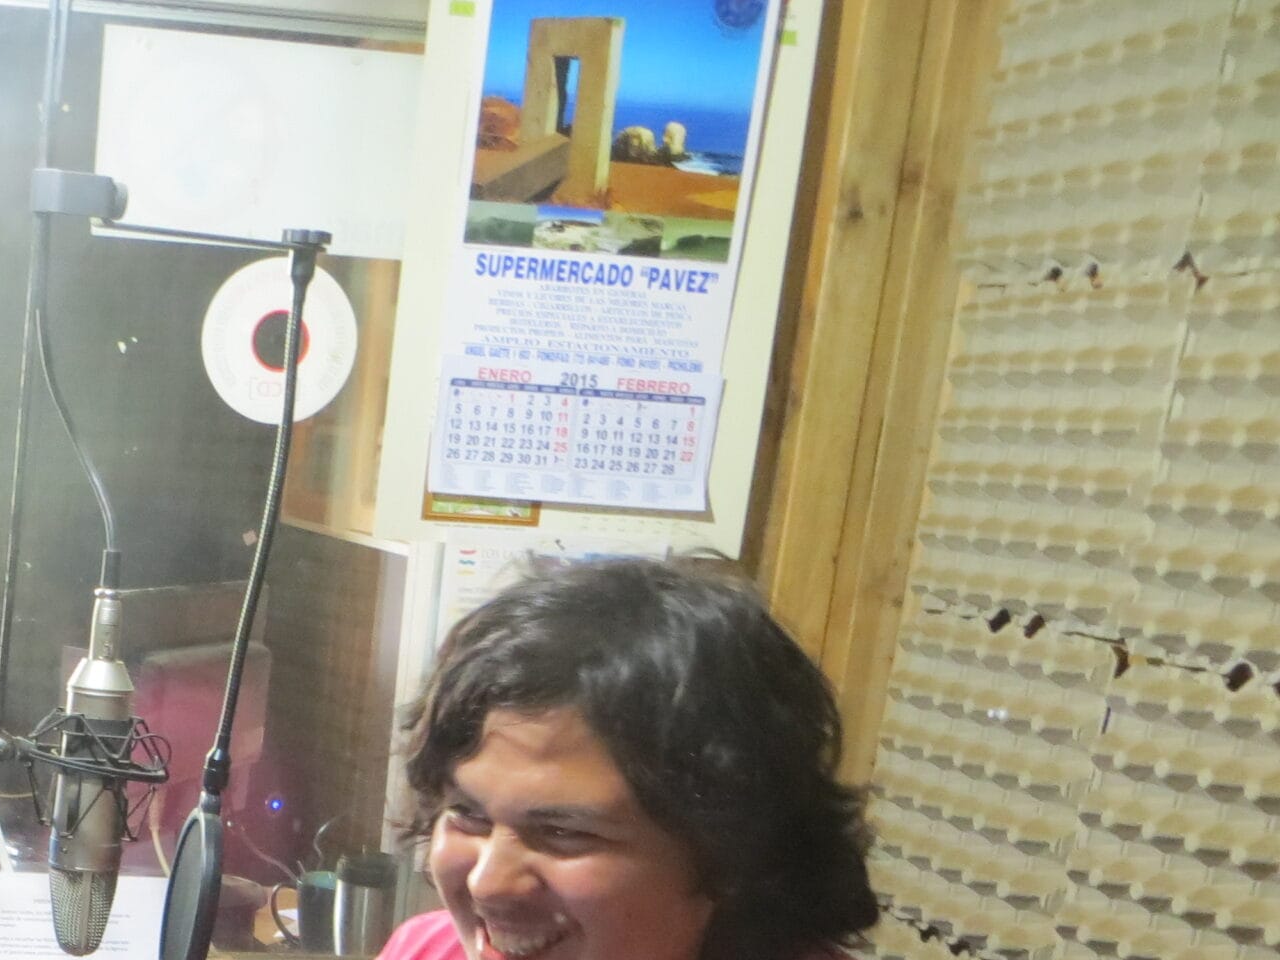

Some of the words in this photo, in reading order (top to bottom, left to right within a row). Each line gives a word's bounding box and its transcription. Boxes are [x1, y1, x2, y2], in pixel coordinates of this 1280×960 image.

[475, 253, 634, 287] SUPERMERCADO
[477, 367, 532, 383] ENERO
[559, 371, 599, 388] 2015
[617, 377, 691, 395] FEBRERO
[541, 410, 553, 422] 10
[558, 412, 568, 423] 11
[450, 418, 462, 429] 12
[469, 420, 481, 431] 13
[486, 421, 498, 432] 14
[503, 422, 516, 434] 15
[521, 423, 535, 435] 16
[539, 425, 552, 436] 17
[556, 426, 568, 438] 18
[596, 429, 608, 441] 10
[613, 430, 624, 441] 11
[630, 432, 643, 444] 12
[648, 433, 660, 445] 13
[666, 435, 678, 445] 14
[448, 433, 461, 444] 19
[466, 434, 480, 446] 20
[483, 436, 496, 447] 21
[501, 437, 514, 449] 22
[519, 438, 533, 449] 23
[536, 439, 550, 451] 24
[553, 441, 568, 453] 25
[577, 443, 590, 454] 16
[594, 444, 607, 455] 17
[611, 445, 623, 456] 18
[629, 447, 641, 458] 19
[645, 448, 659, 459] 20
[663, 449, 676, 461] 21
[446, 447, 460, 459] 26
[465, 449, 479, 460] 27
[481, 450, 495, 462] 28
[500, 452, 513, 463] 29
[517, 453, 531, 464] 30
[534, 455, 547, 465] 31
[574, 457, 588, 469] 23
[591, 459, 605, 470] 24
[608, 460, 623, 471] 25
[626, 461, 640, 473] 26
[643, 462, 658, 474] 27
